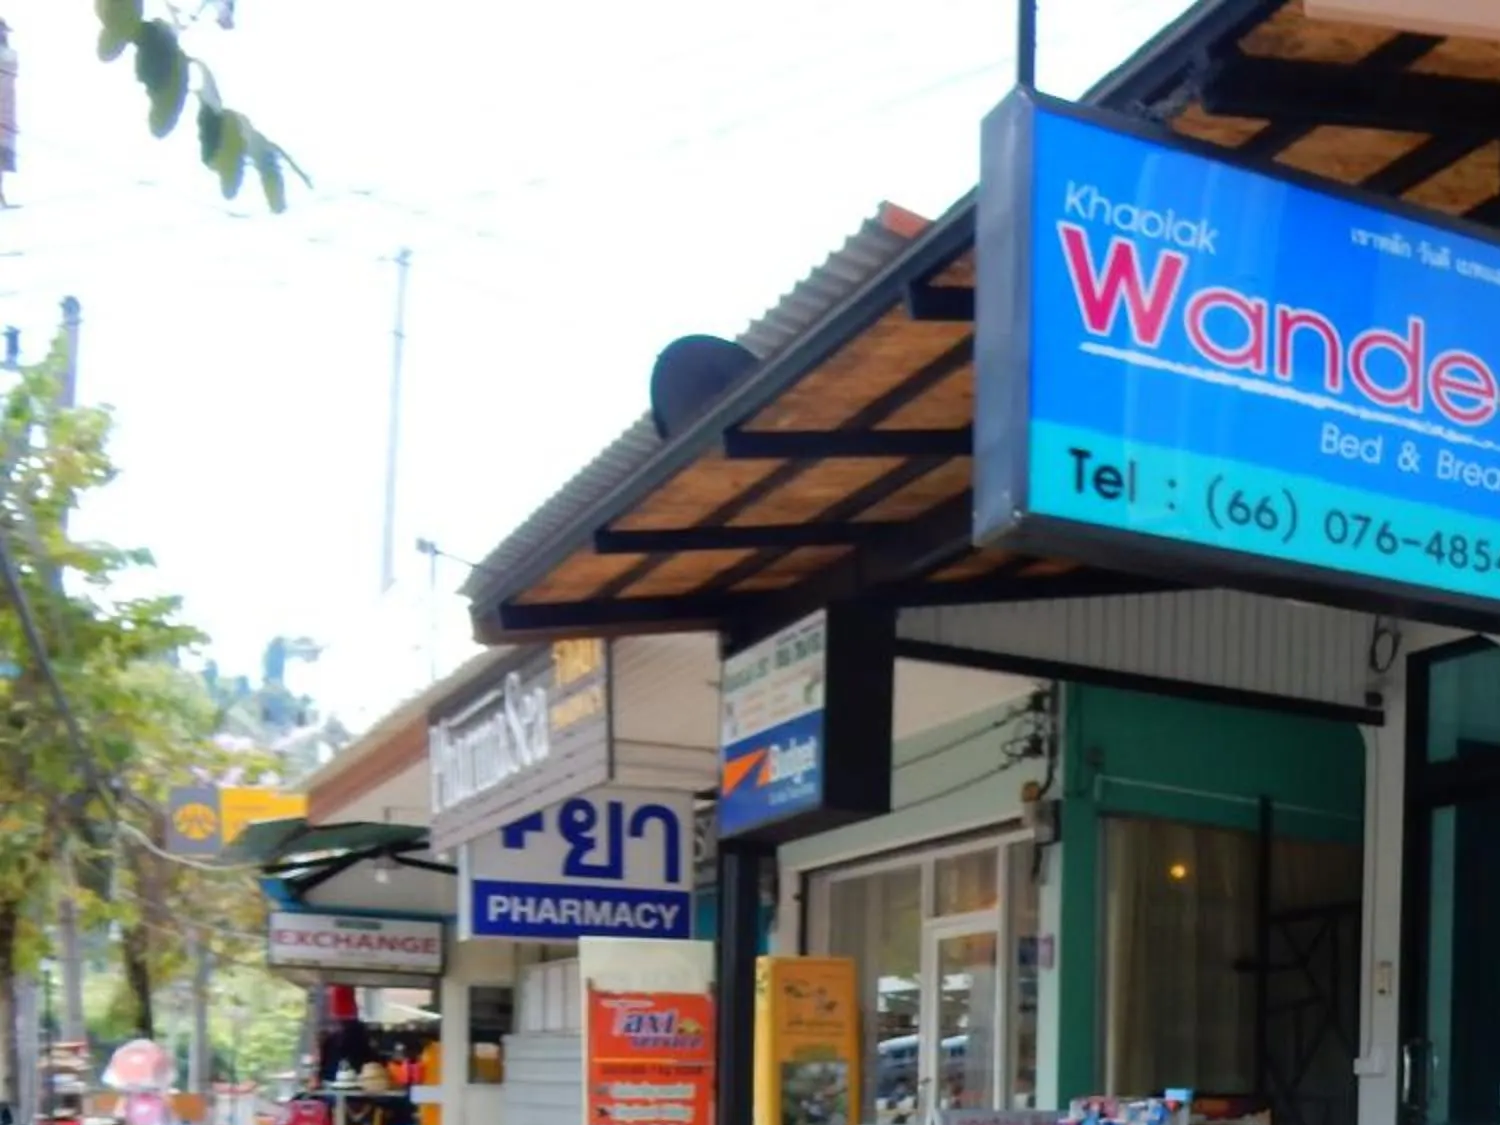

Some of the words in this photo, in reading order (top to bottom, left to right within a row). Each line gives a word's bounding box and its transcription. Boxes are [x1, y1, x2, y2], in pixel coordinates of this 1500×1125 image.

[1063, 179, 1220, 256] Khaolak
[1320, 422, 1384, 465] Bed
[1397, 440, 1421, 474] &
[1068, 446, 1139, 505] Tel
[1204, 474, 1300, 546] (66)
[487, 894, 681, 930] PHARMACY
[273, 928, 438, 955] EXCHANGE
